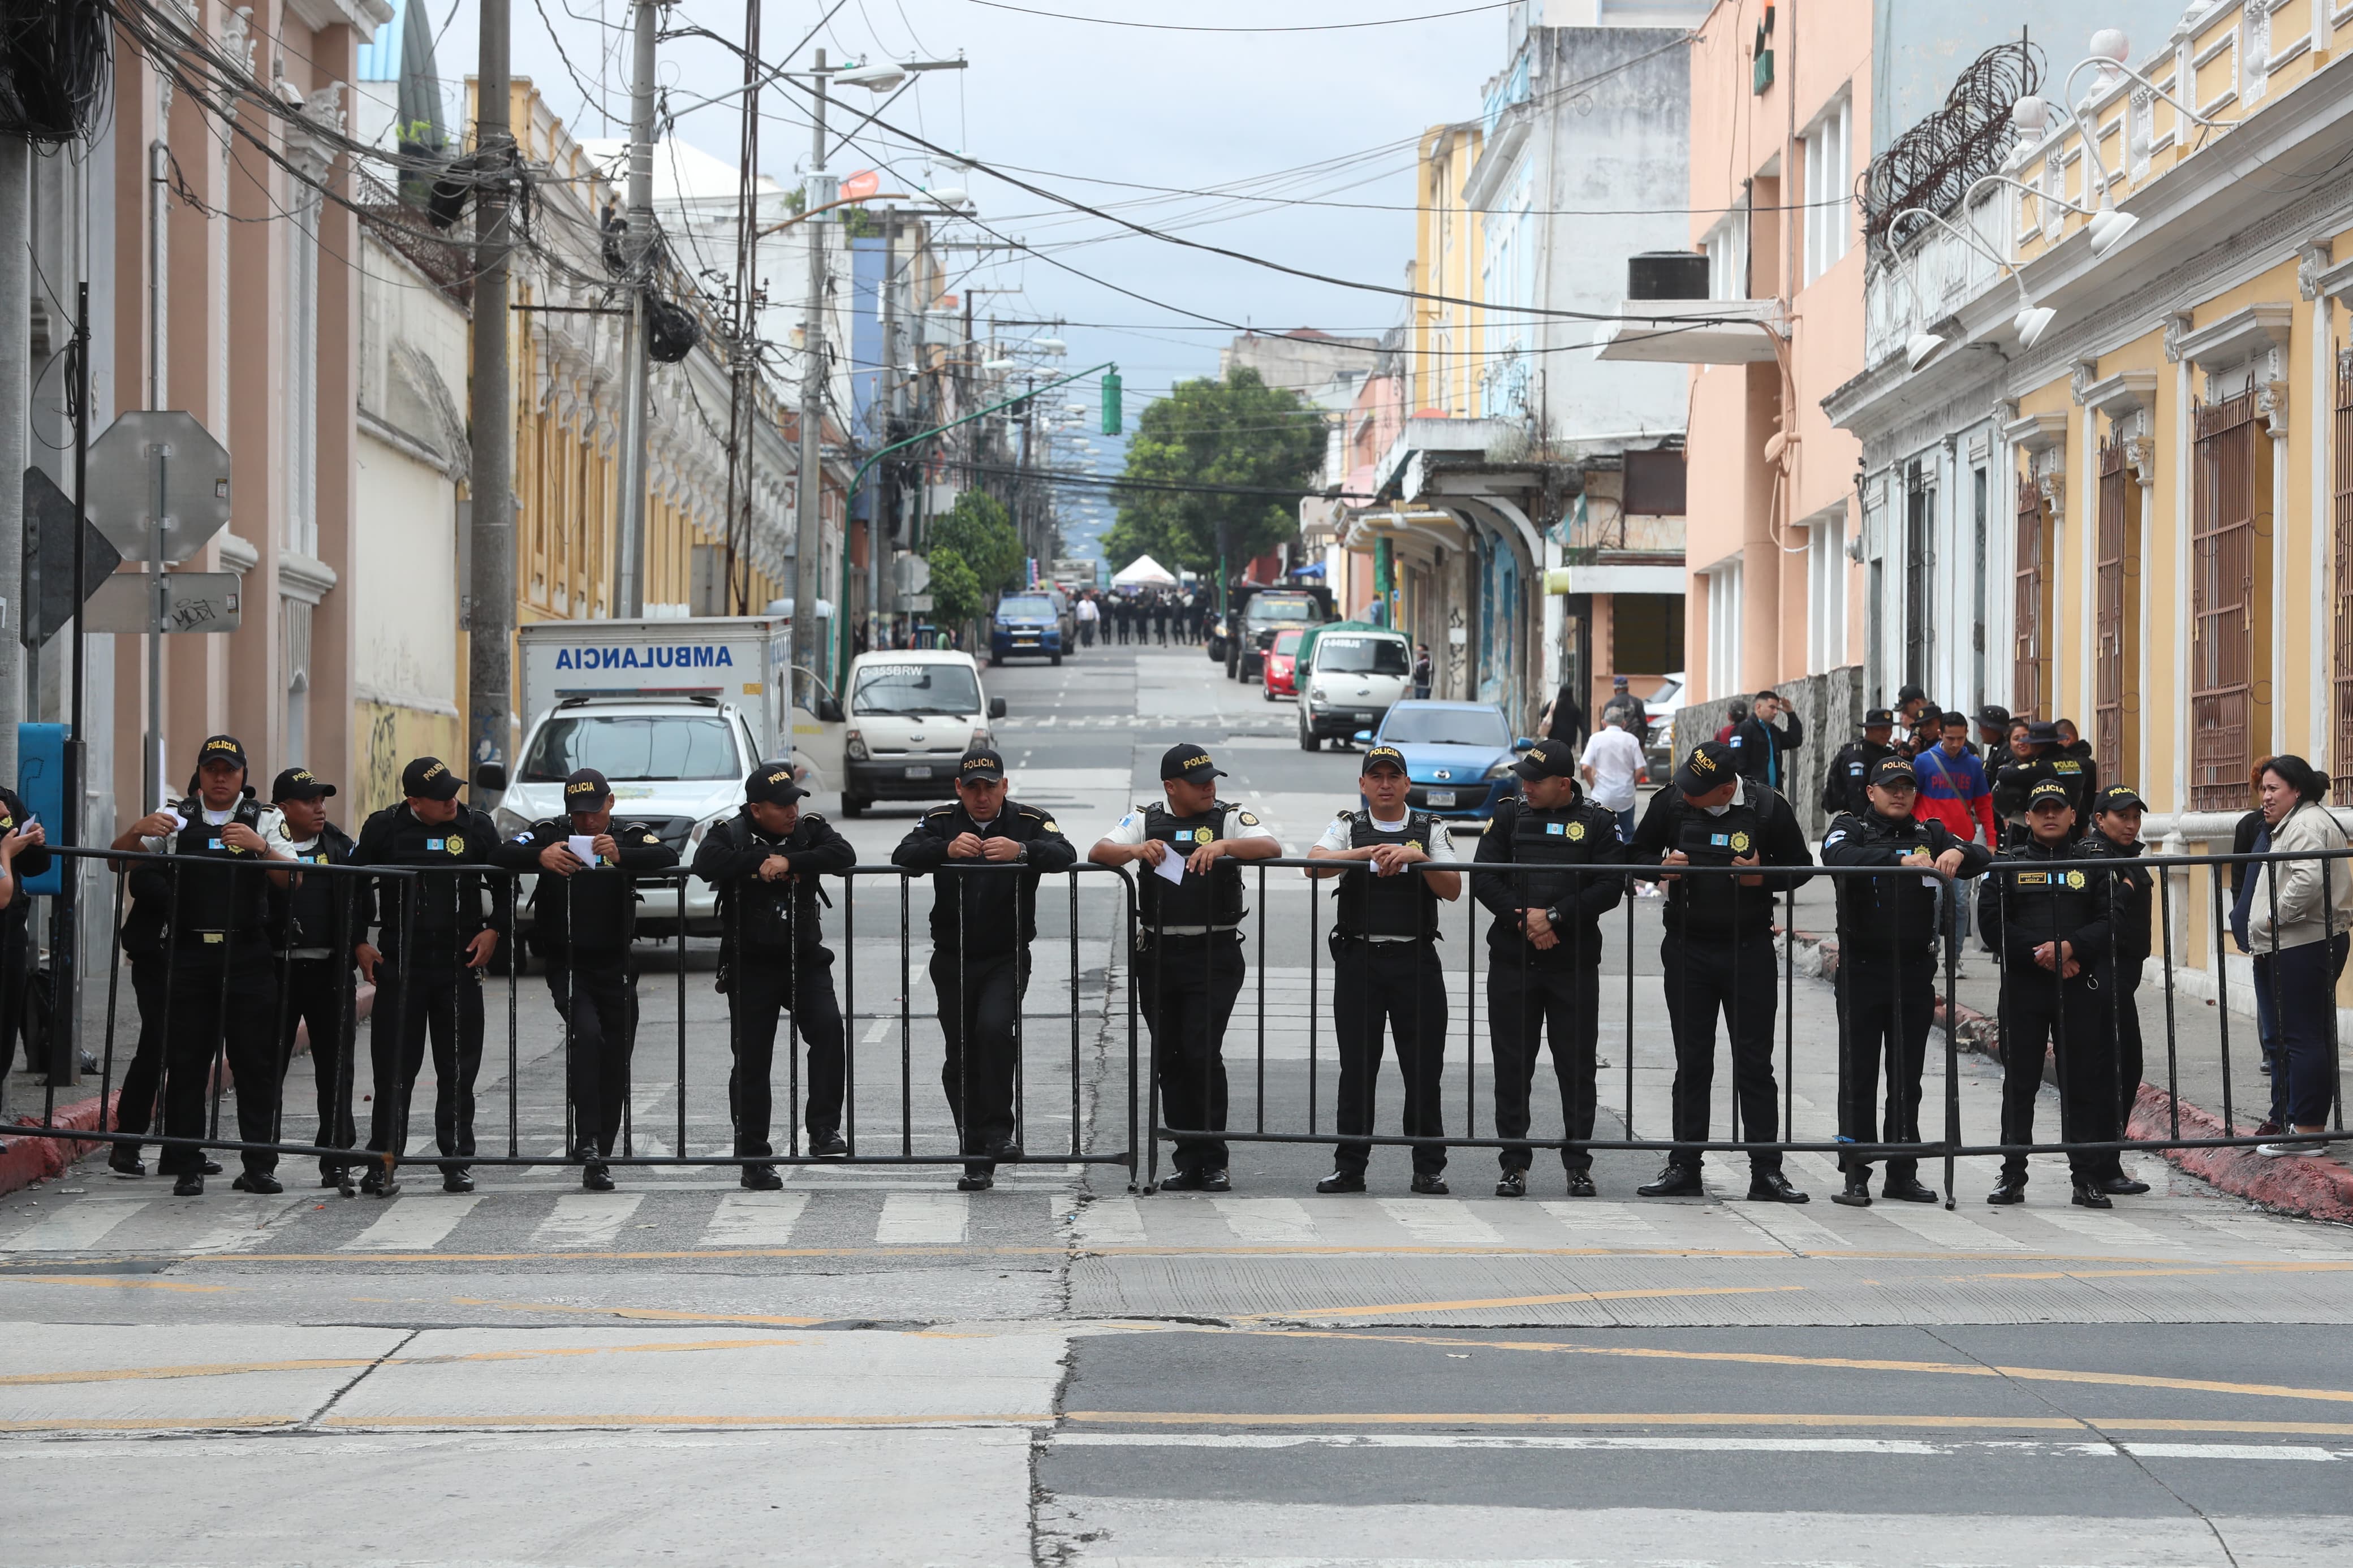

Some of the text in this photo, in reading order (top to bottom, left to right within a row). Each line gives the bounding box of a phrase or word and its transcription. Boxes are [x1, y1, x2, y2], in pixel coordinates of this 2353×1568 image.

[206, 740, 237, 753] POLICIA
[1370, 748, 1399, 758] POLICIA
[963, 758, 996, 772] POLICIA
[1694, 748, 1717, 772] POLICIA
[1882, 761, 1912, 772] POLICIA
[2052, 760, 2080, 769] POLICIA
[567, 781, 595, 796] POLICIA
[2031, 784, 2066, 797] POLICIA
